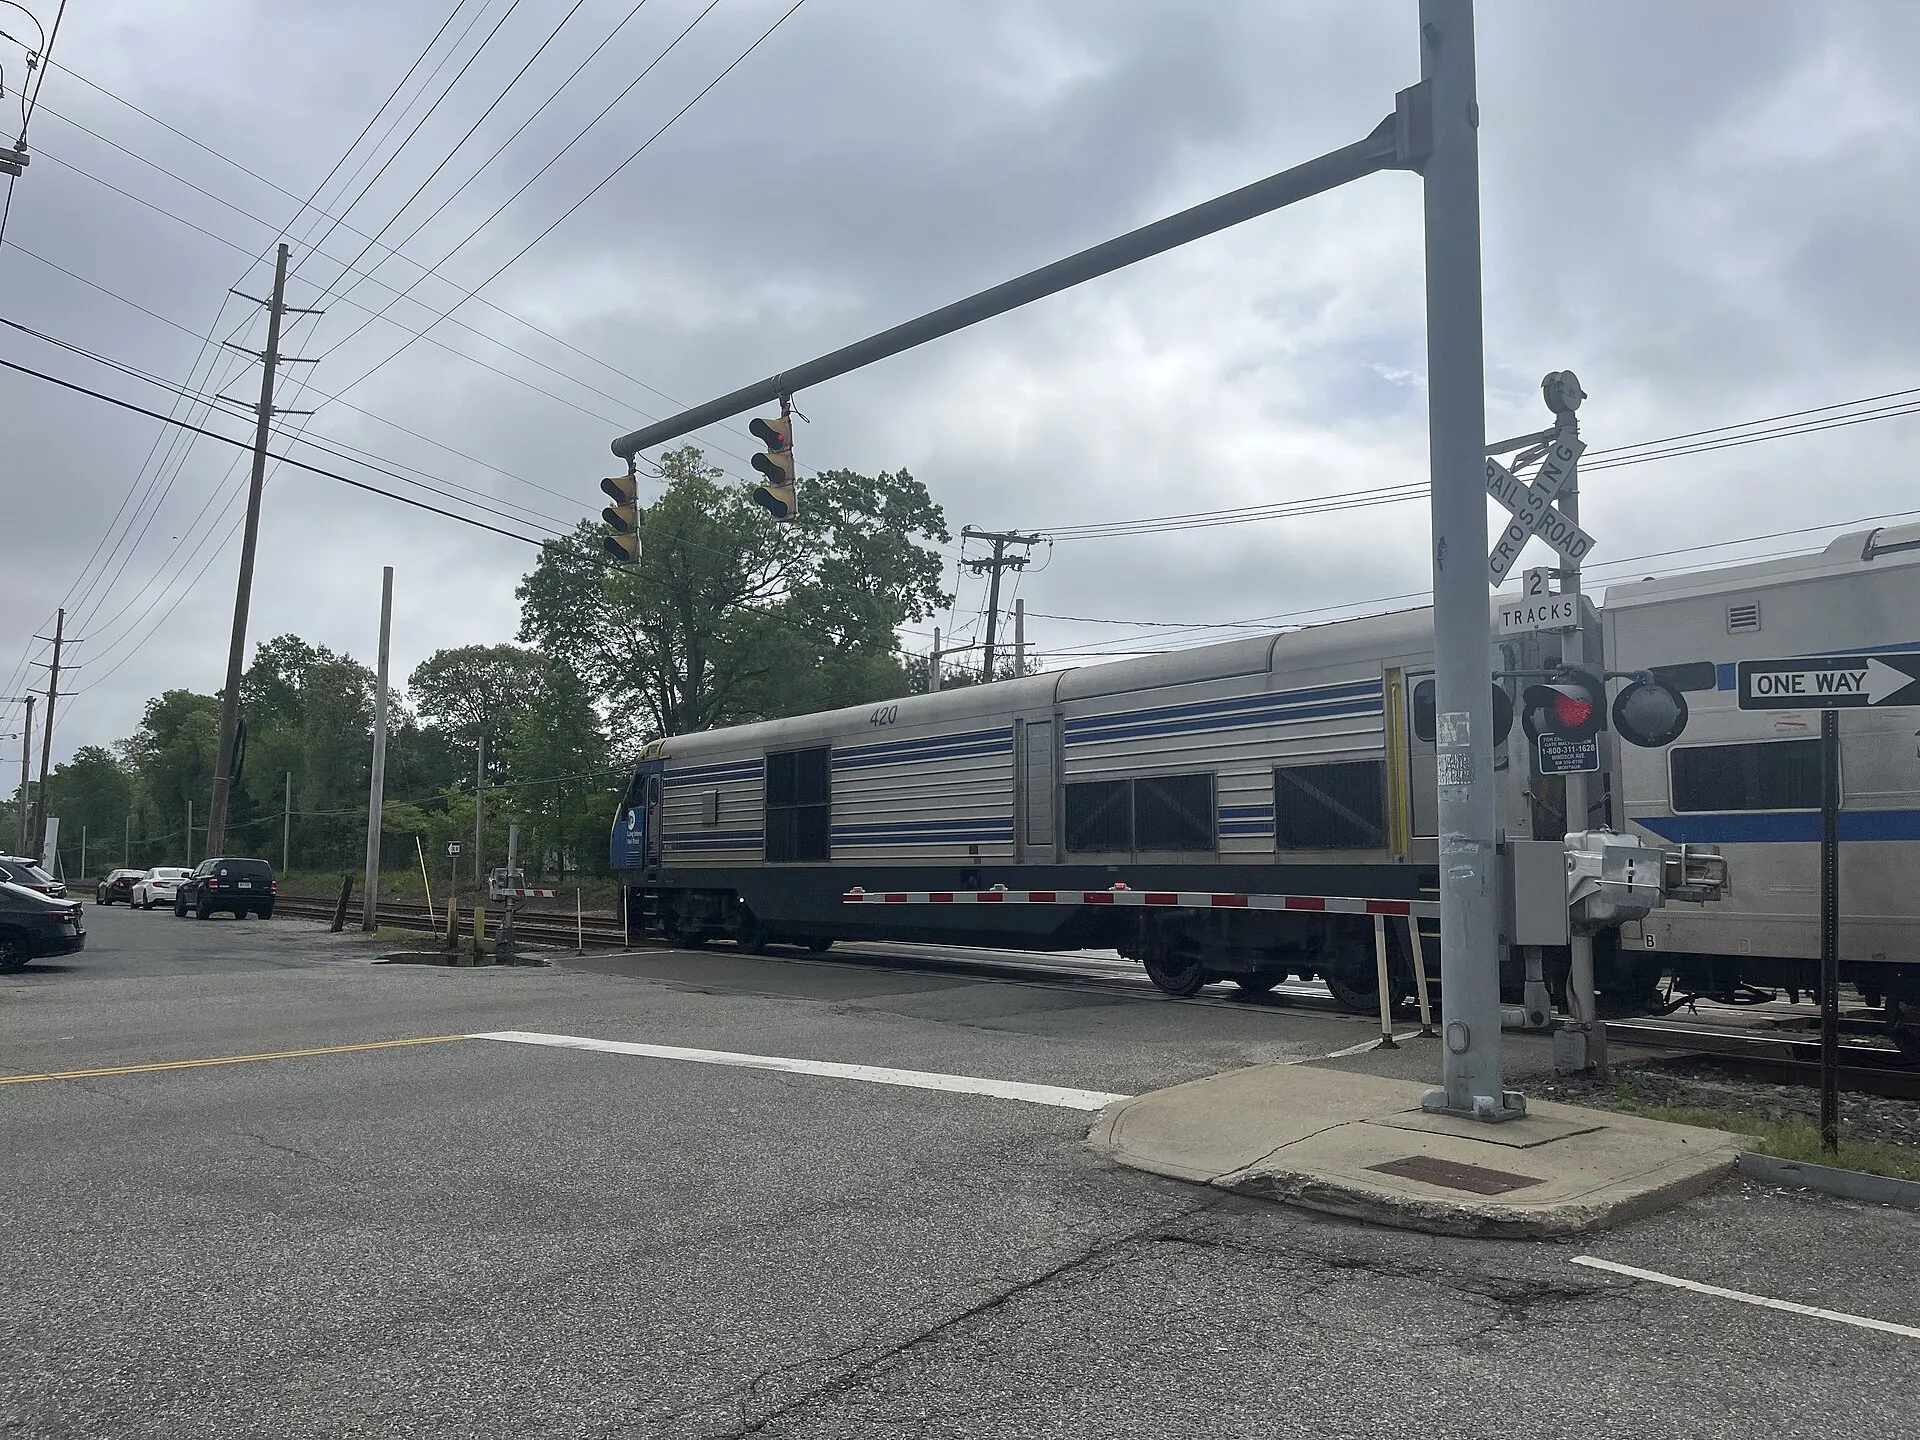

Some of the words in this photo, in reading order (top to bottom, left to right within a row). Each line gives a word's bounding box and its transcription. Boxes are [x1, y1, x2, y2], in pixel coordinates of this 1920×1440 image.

[1485, 464, 1518, 508] RAIL
[1540, 512, 1587, 558] ROAD
[1490, 444, 1573, 574] CROSSING
[1529, 572, 1542, 595] 2
[1503, 602, 1572, 627] TRACKS
[1757, 674, 1806, 695] ONE
[1815, 671, 1867, 693] WAY
[870, 705, 898, 727] 420
[1542, 744, 1595, 754] 1-800-311-1628
[1646, 935, 1654, 947] B
